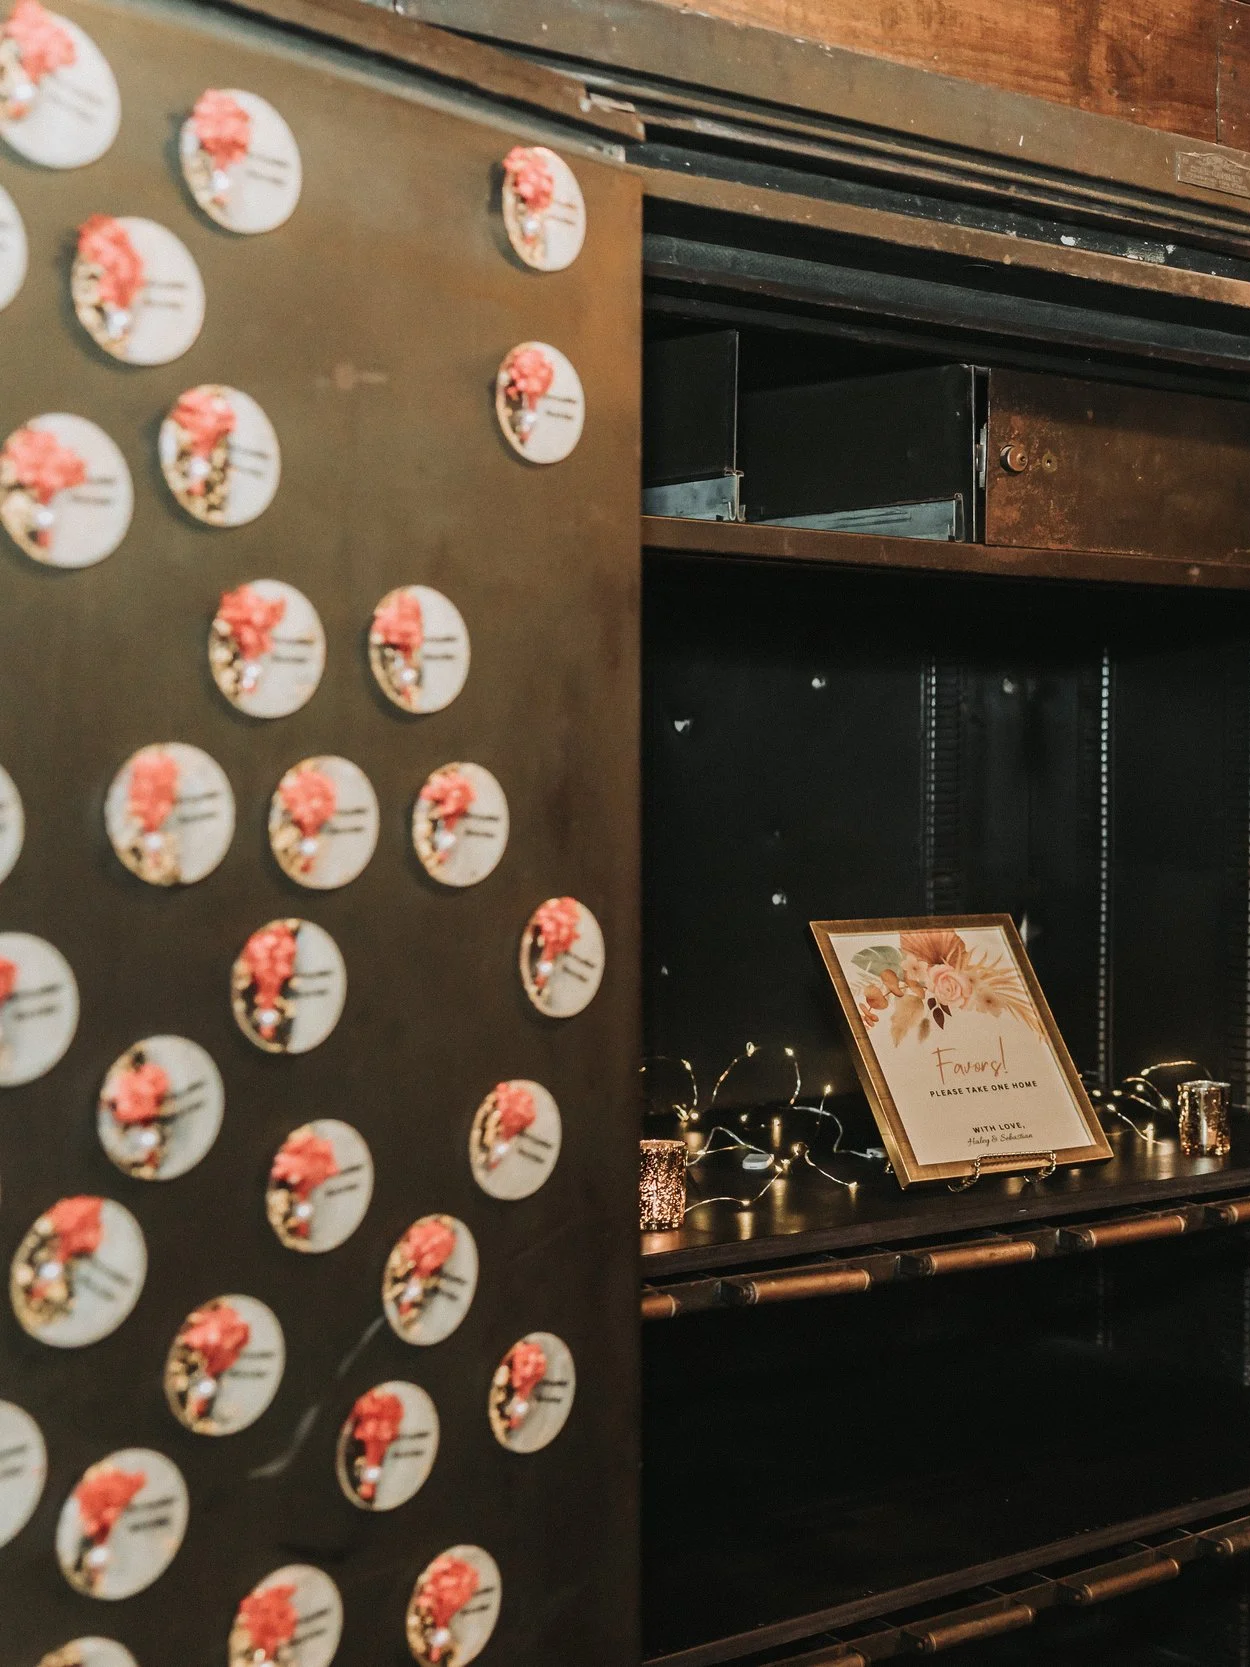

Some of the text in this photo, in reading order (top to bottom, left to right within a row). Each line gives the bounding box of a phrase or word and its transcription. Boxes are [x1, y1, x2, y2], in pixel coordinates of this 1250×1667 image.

[931, 1036, 1008, 1085] Favors!
[930, 1080, 1037, 1097] PLEASE TAKE ONE HOME
[972, 1122, 1025, 1133] WITH LOVE,
